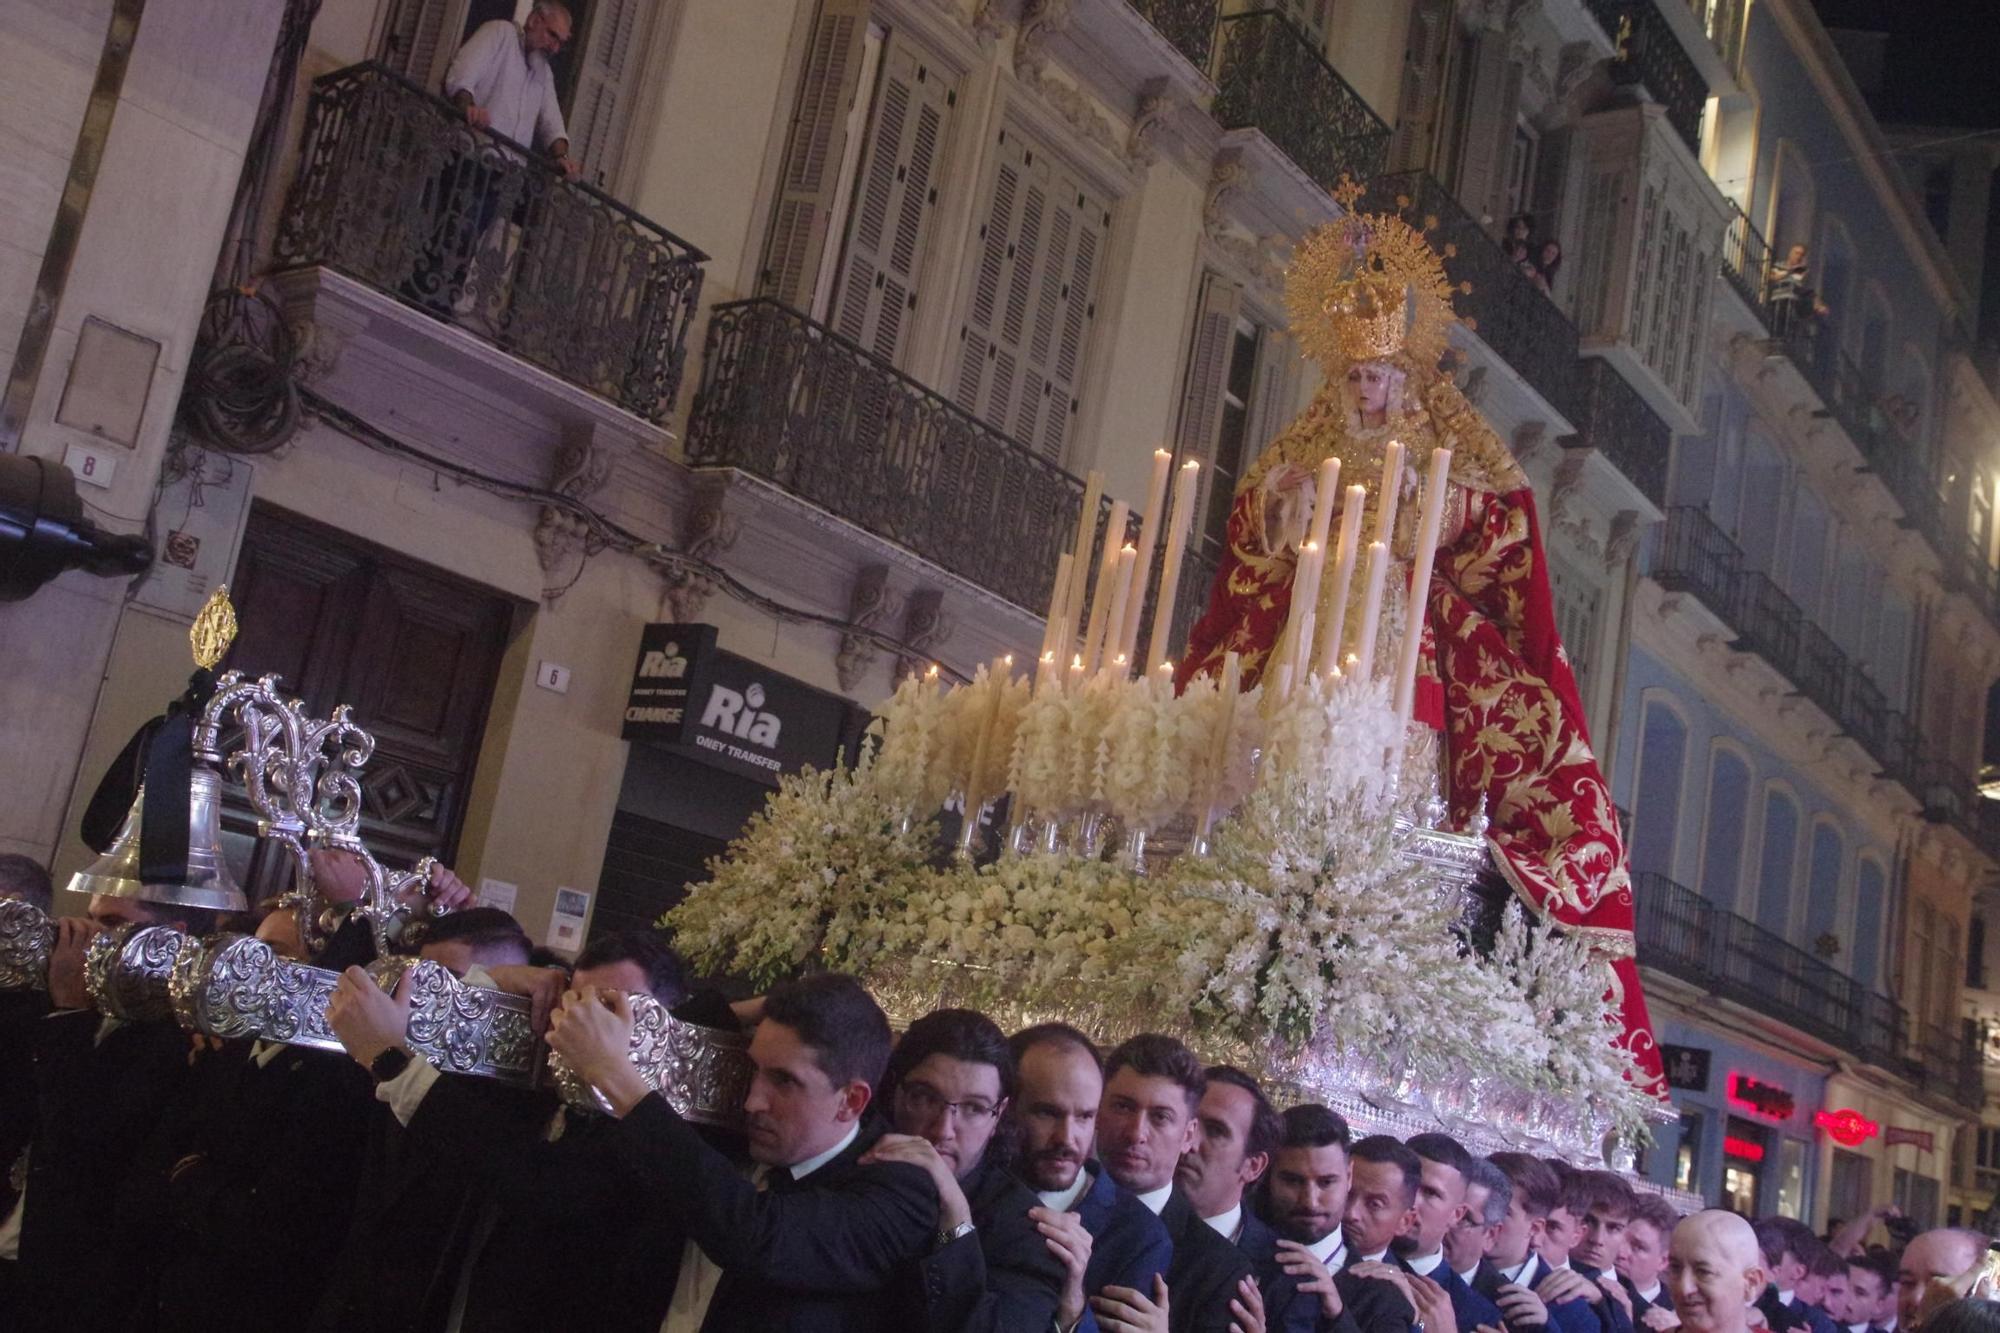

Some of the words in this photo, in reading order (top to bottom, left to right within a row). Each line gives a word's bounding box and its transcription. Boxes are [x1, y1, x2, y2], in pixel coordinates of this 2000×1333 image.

[83, 456, 96, 476] 8
[550, 669, 559, 685] 6
[639, 641, 688, 678] Ria
[701, 682, 781, 749] Ria
[696, 734, 727, 753] ONEY
[727, 744, 782, 772] TRANSFER
